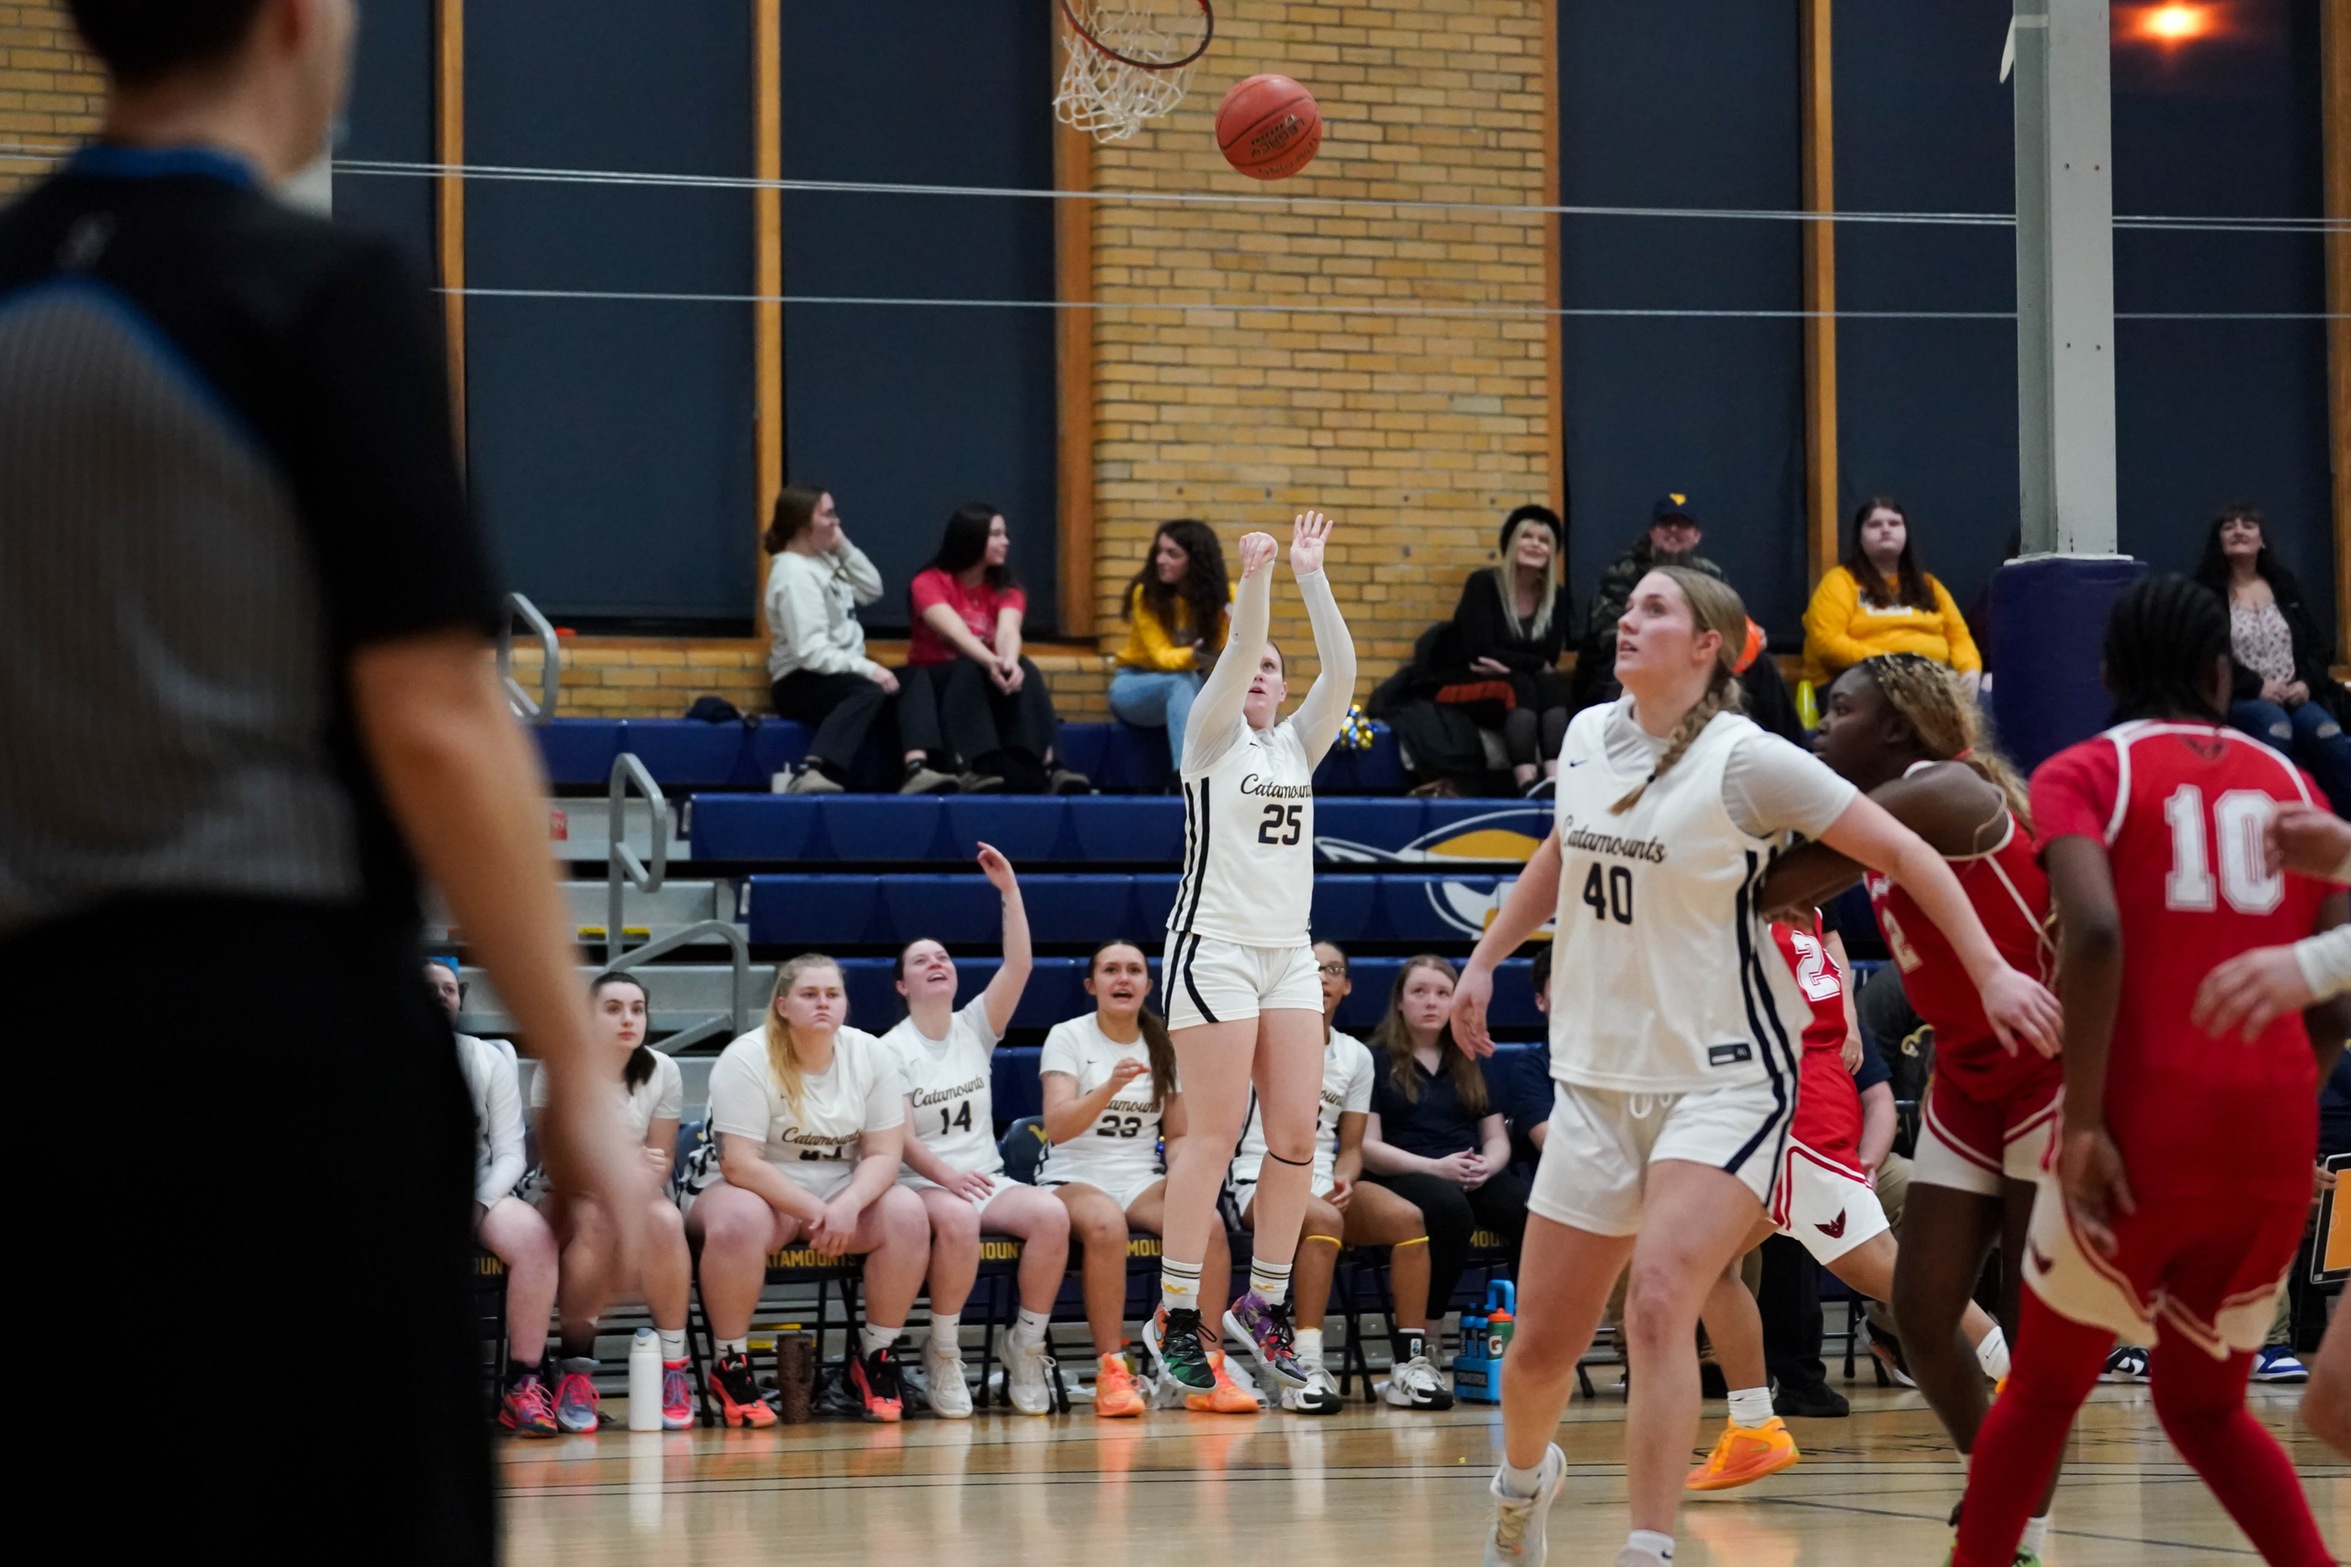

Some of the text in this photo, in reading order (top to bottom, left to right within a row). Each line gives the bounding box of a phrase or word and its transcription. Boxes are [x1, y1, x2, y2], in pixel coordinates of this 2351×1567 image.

[1258, 804, 1303, 846] 25
[1563, 814, 1667, 864] Catamounts
[2163, 782, 2286, 916] 10
[1583, 862, 1632, 925] 40
[912, 1075, 985, 1108] Catamounts
[941, 1100, 972, 1135] 14
[1096, 1115, 1142, 1138] 23
